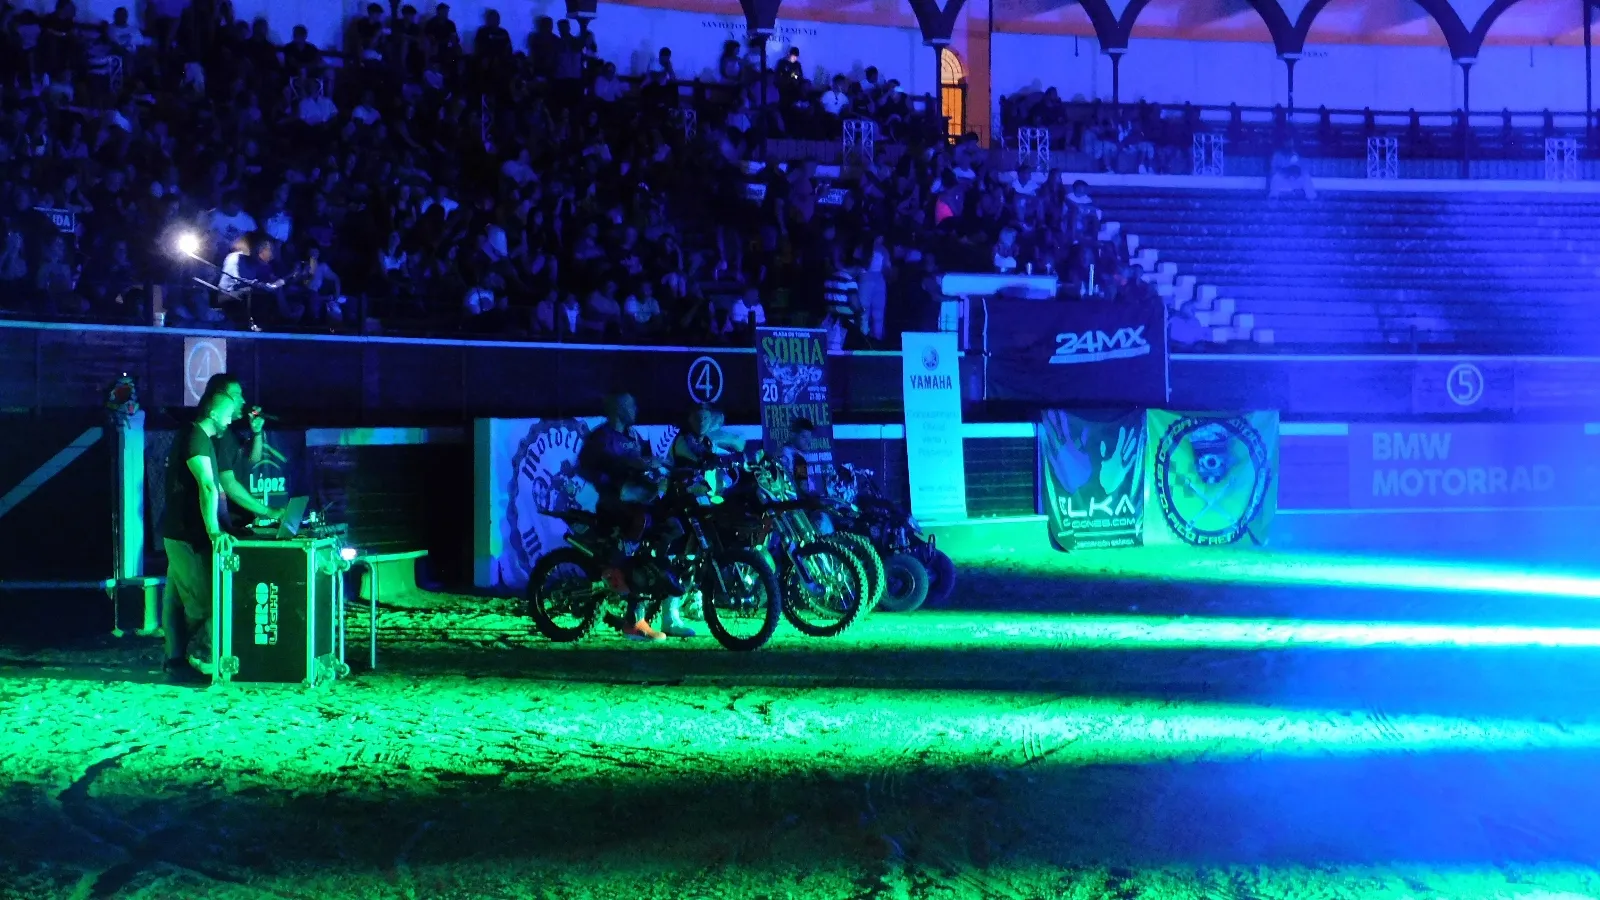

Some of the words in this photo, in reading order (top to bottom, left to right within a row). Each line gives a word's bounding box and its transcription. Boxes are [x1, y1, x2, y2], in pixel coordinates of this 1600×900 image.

[761, 335, 825, 366] SORIA
[1055, 325, 1147, 354] 24MX
[762, 383, 779, 403] 20
[909, 374, 953, 390] YAMAHA
[1372, 432, 1452, 461] BMW
[249, 472, 286, 507] López
[1372, 463, 1556, 497] MOTORRAD
